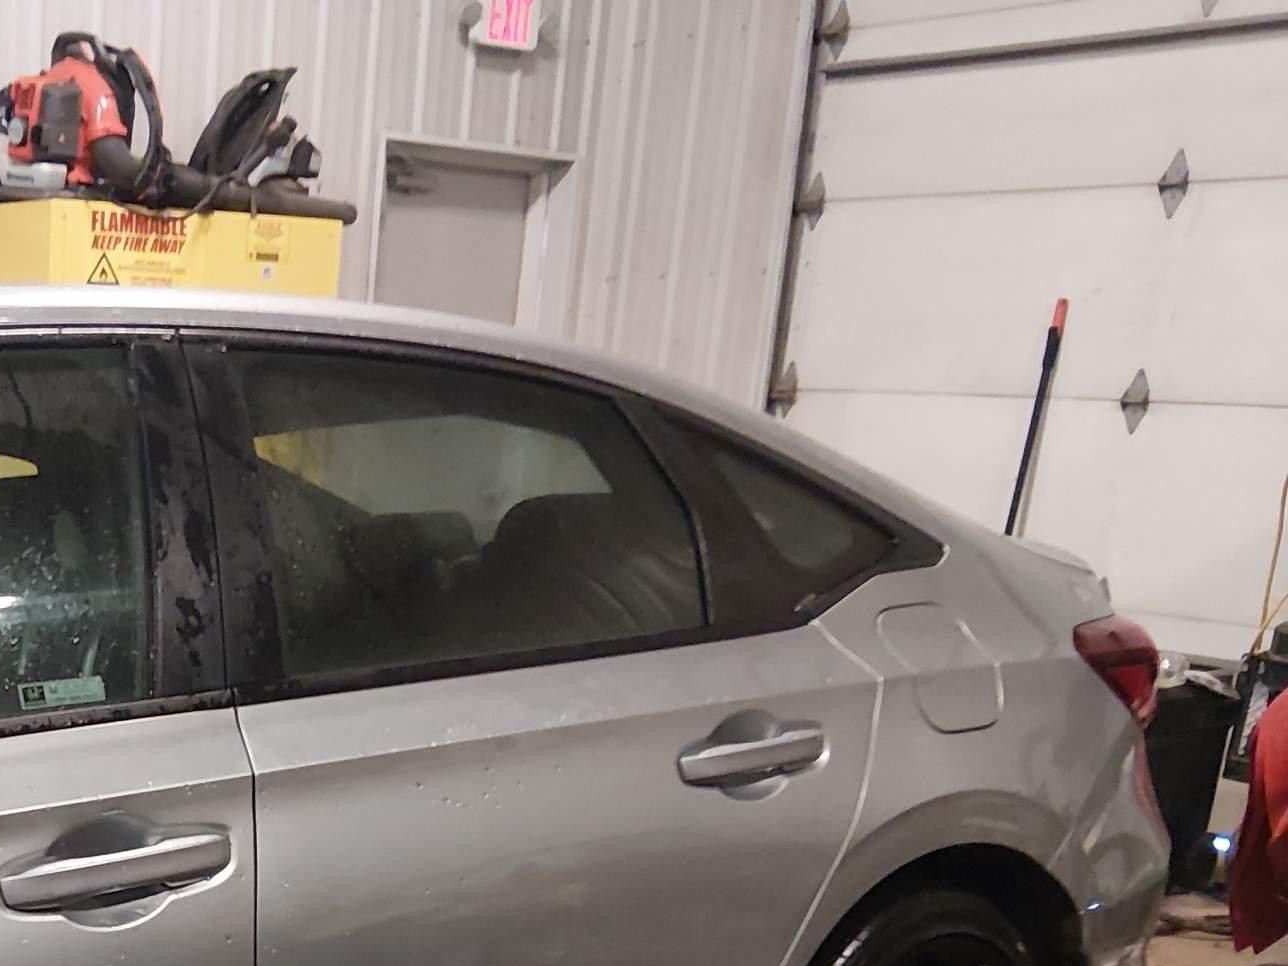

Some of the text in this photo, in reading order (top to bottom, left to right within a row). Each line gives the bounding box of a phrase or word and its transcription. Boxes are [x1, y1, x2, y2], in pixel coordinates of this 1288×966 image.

[488, 0, 535, 42] EXIT
[91, 210, 187, 237] FLAMMABLE
[91, 234, 186, 255] KEEP FIRE AWAY
